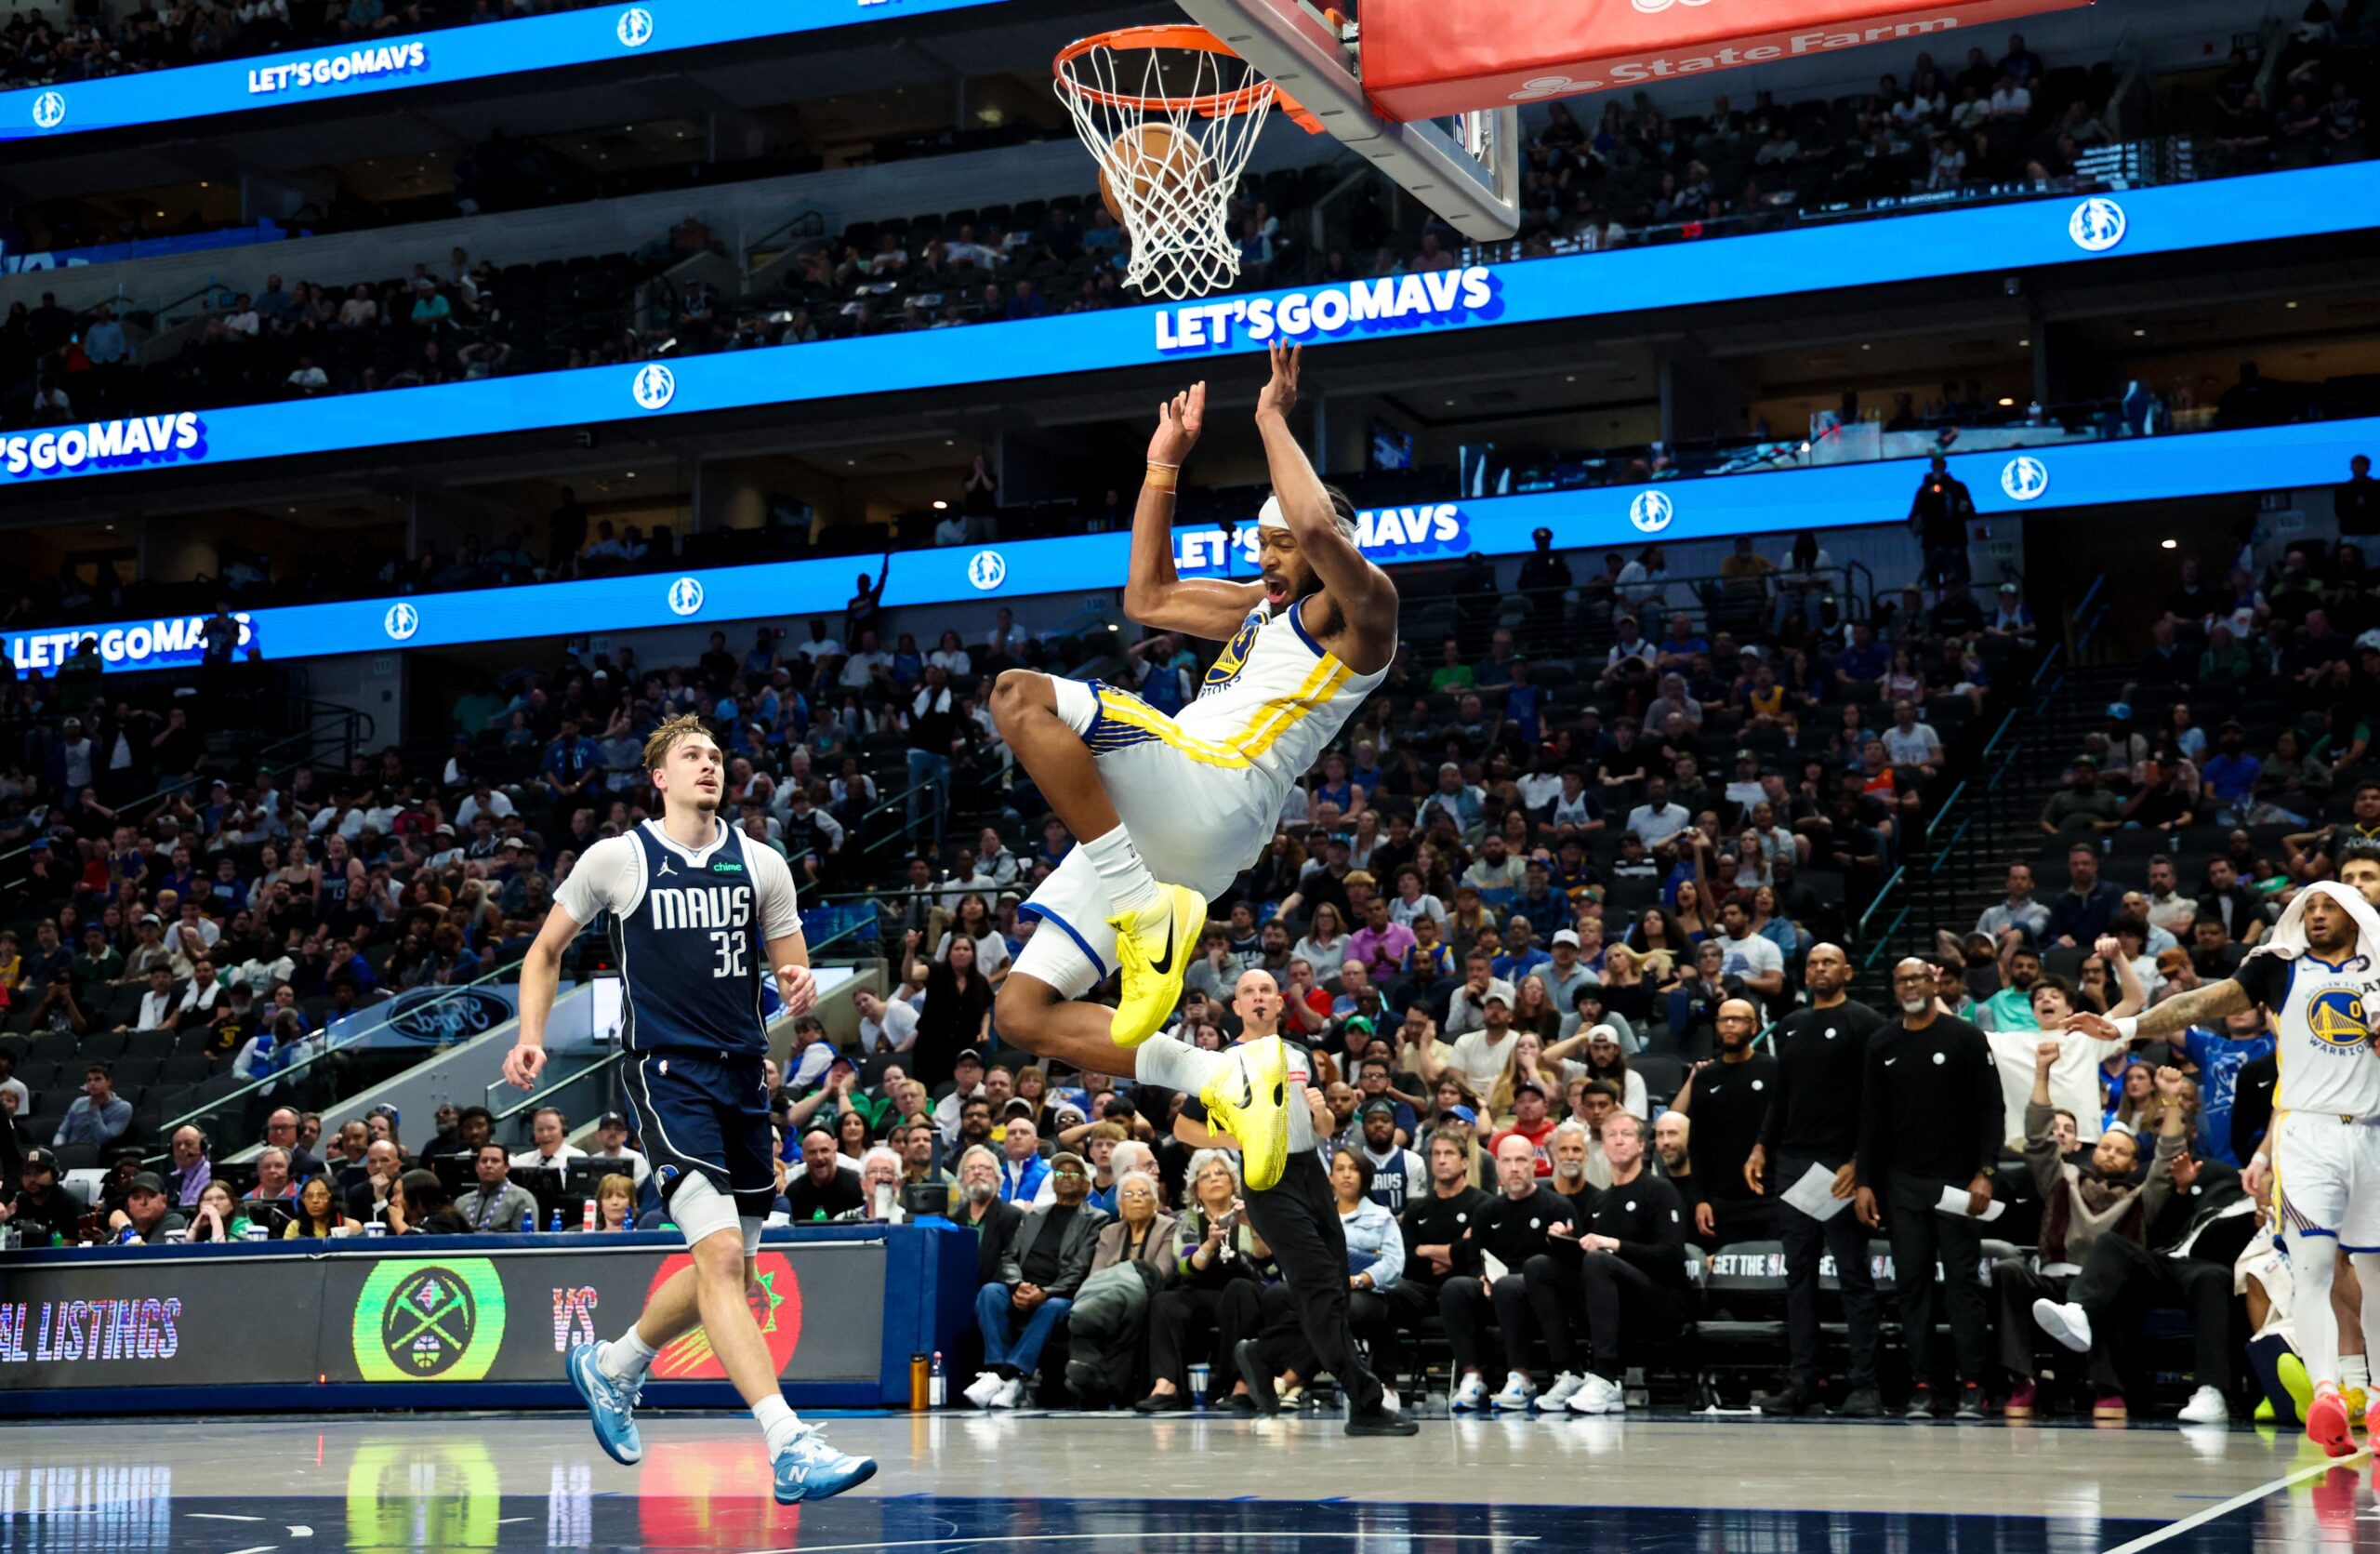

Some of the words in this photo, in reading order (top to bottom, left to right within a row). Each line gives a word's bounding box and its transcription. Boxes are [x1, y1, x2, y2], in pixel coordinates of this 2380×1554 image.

[1609, 46, 1781, 84] State
[1791, 16, 1958, 54] Farm
[714, 862, 743, 872] chime
[651, 886, 751, 930] MAVS
[709, 930, 747, 978] 32
[1389, 1189, 1403, 1208] 11
[1712, 1254, 1738, 1275] GET
[1739, 1255, 1765, 1276] THE
[35, 1297, 181, 1361] LISTINGS
[552, 1285, 598, 1352] VS
